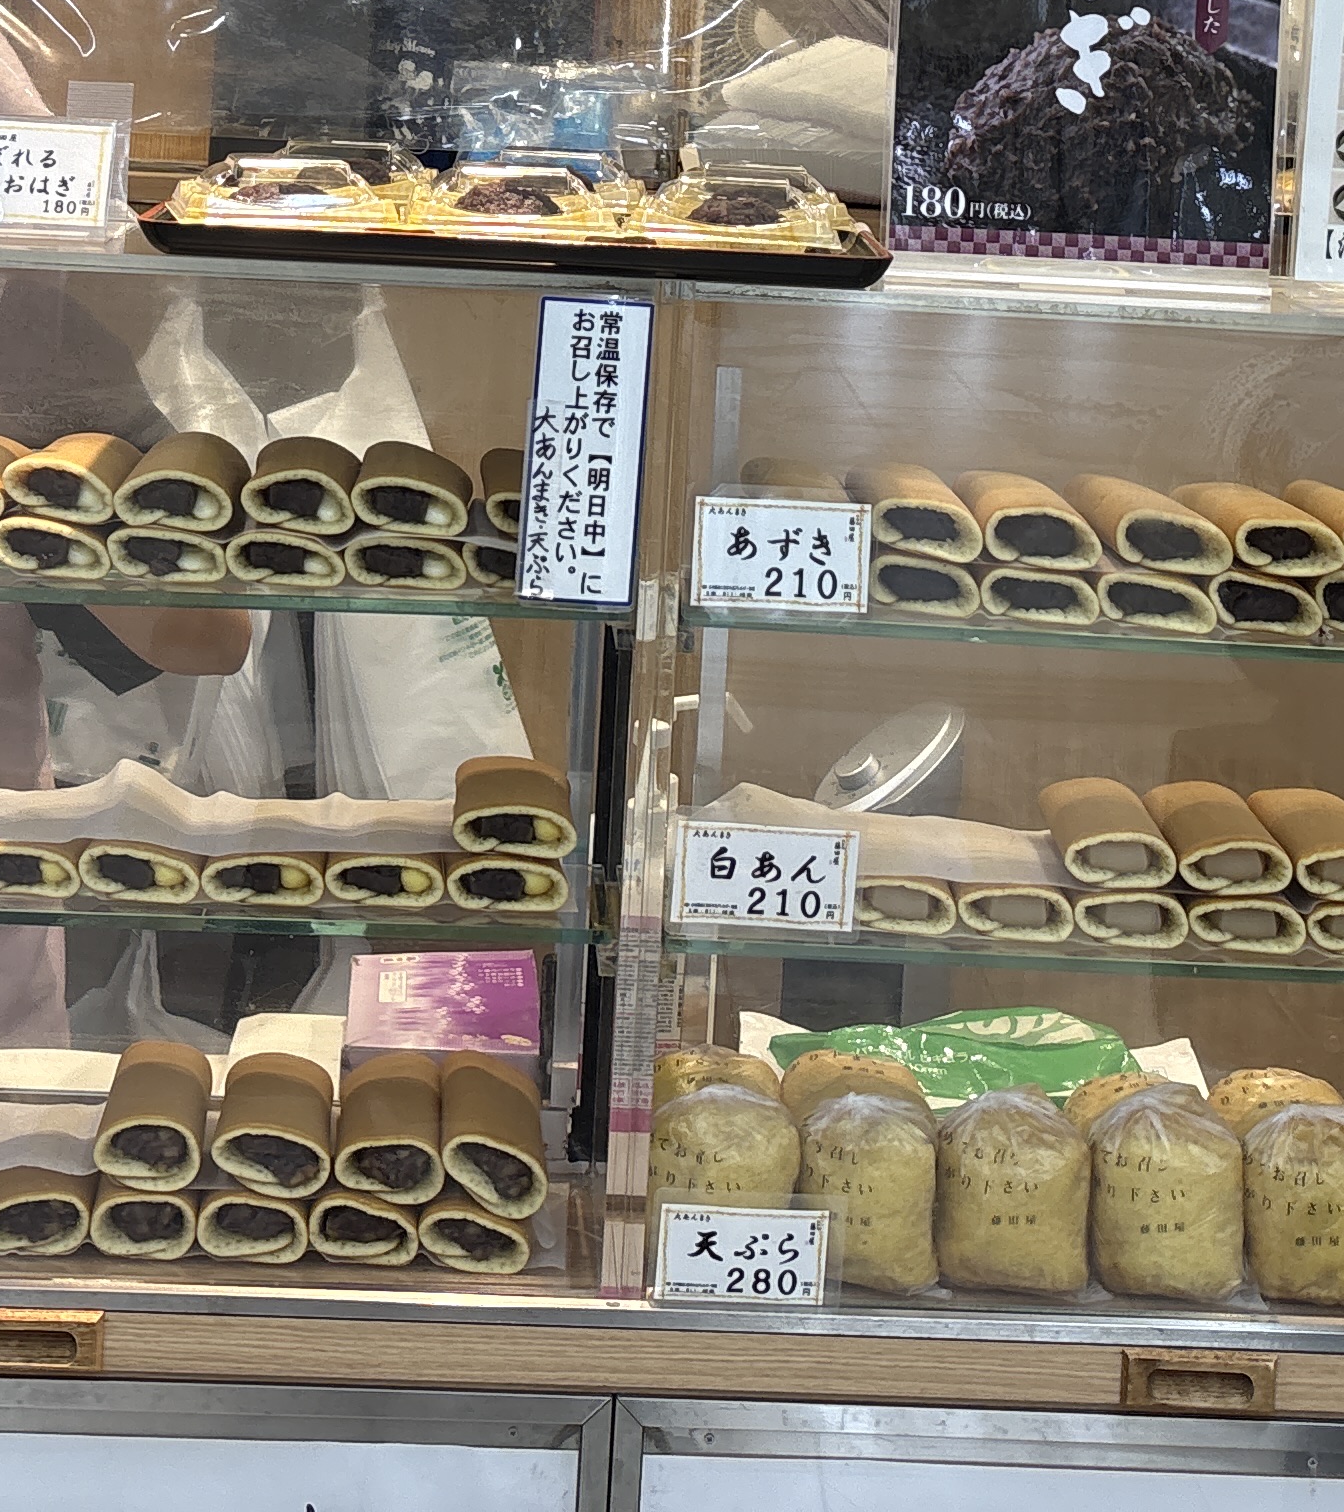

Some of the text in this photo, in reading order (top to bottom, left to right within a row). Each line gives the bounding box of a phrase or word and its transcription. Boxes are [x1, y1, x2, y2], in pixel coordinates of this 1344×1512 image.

[3, 174, 76, 198] おはぎ
[42, 198, 78, 216] 180
[554, 308, 596, 576] お召し上がりください。
[727, 526, 832, 566] あずき
[764, 566, 838, 600] 210
[710, 846, 826, 884] 白あん
[746, 887, 821, 919] 210
[687, 1230, 800, 1265] 天ぷら
[726, 1267, 798, 1296] 280
